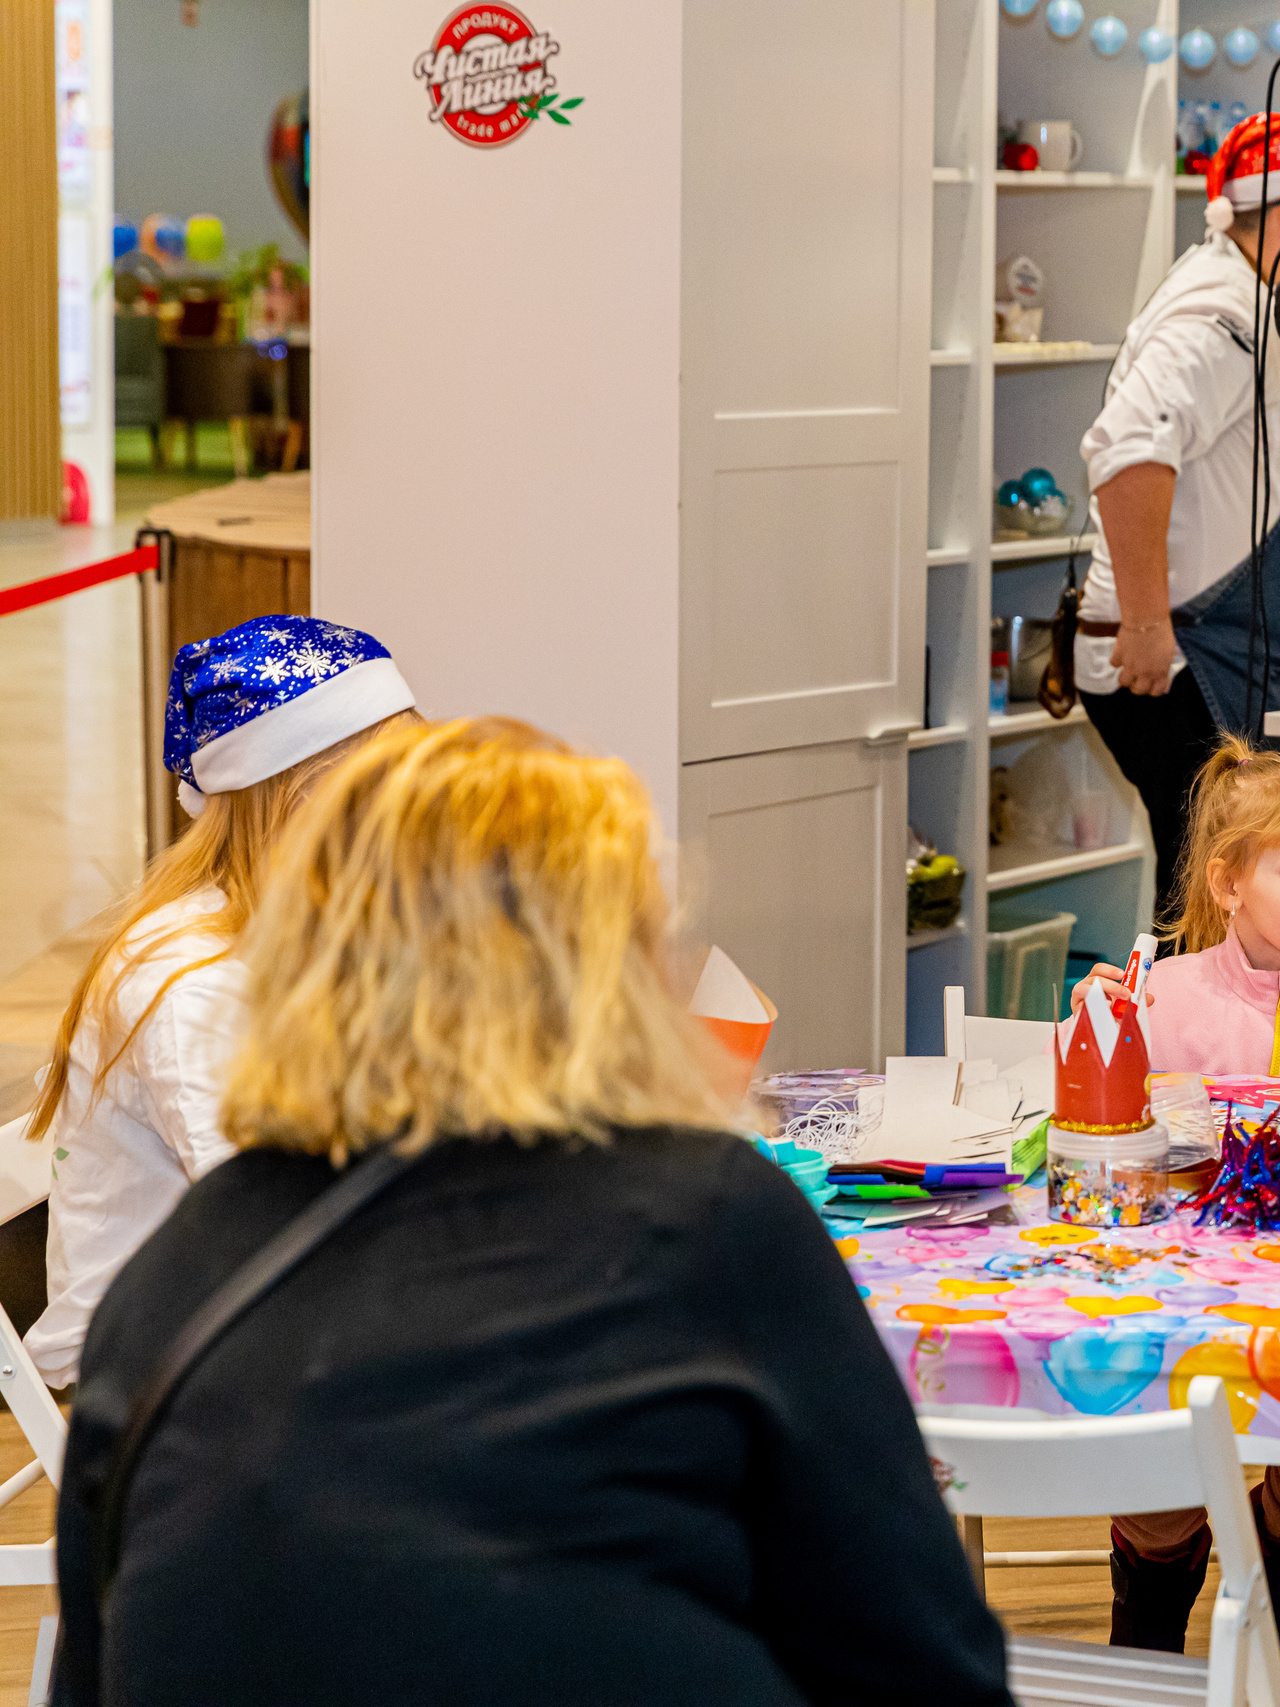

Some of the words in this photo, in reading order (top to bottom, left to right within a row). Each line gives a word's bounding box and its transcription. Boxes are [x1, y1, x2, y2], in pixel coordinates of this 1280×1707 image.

[452, 12, 519, 39] ПРОДУКТ
[413, 32, 560, 85] Чистая
[429, 67, 556, 122] Линия
[456, 114, 494, 138] trade
[499, 105, 530, 133] mar
[1124, 959, 1137, 987] Berlingo
